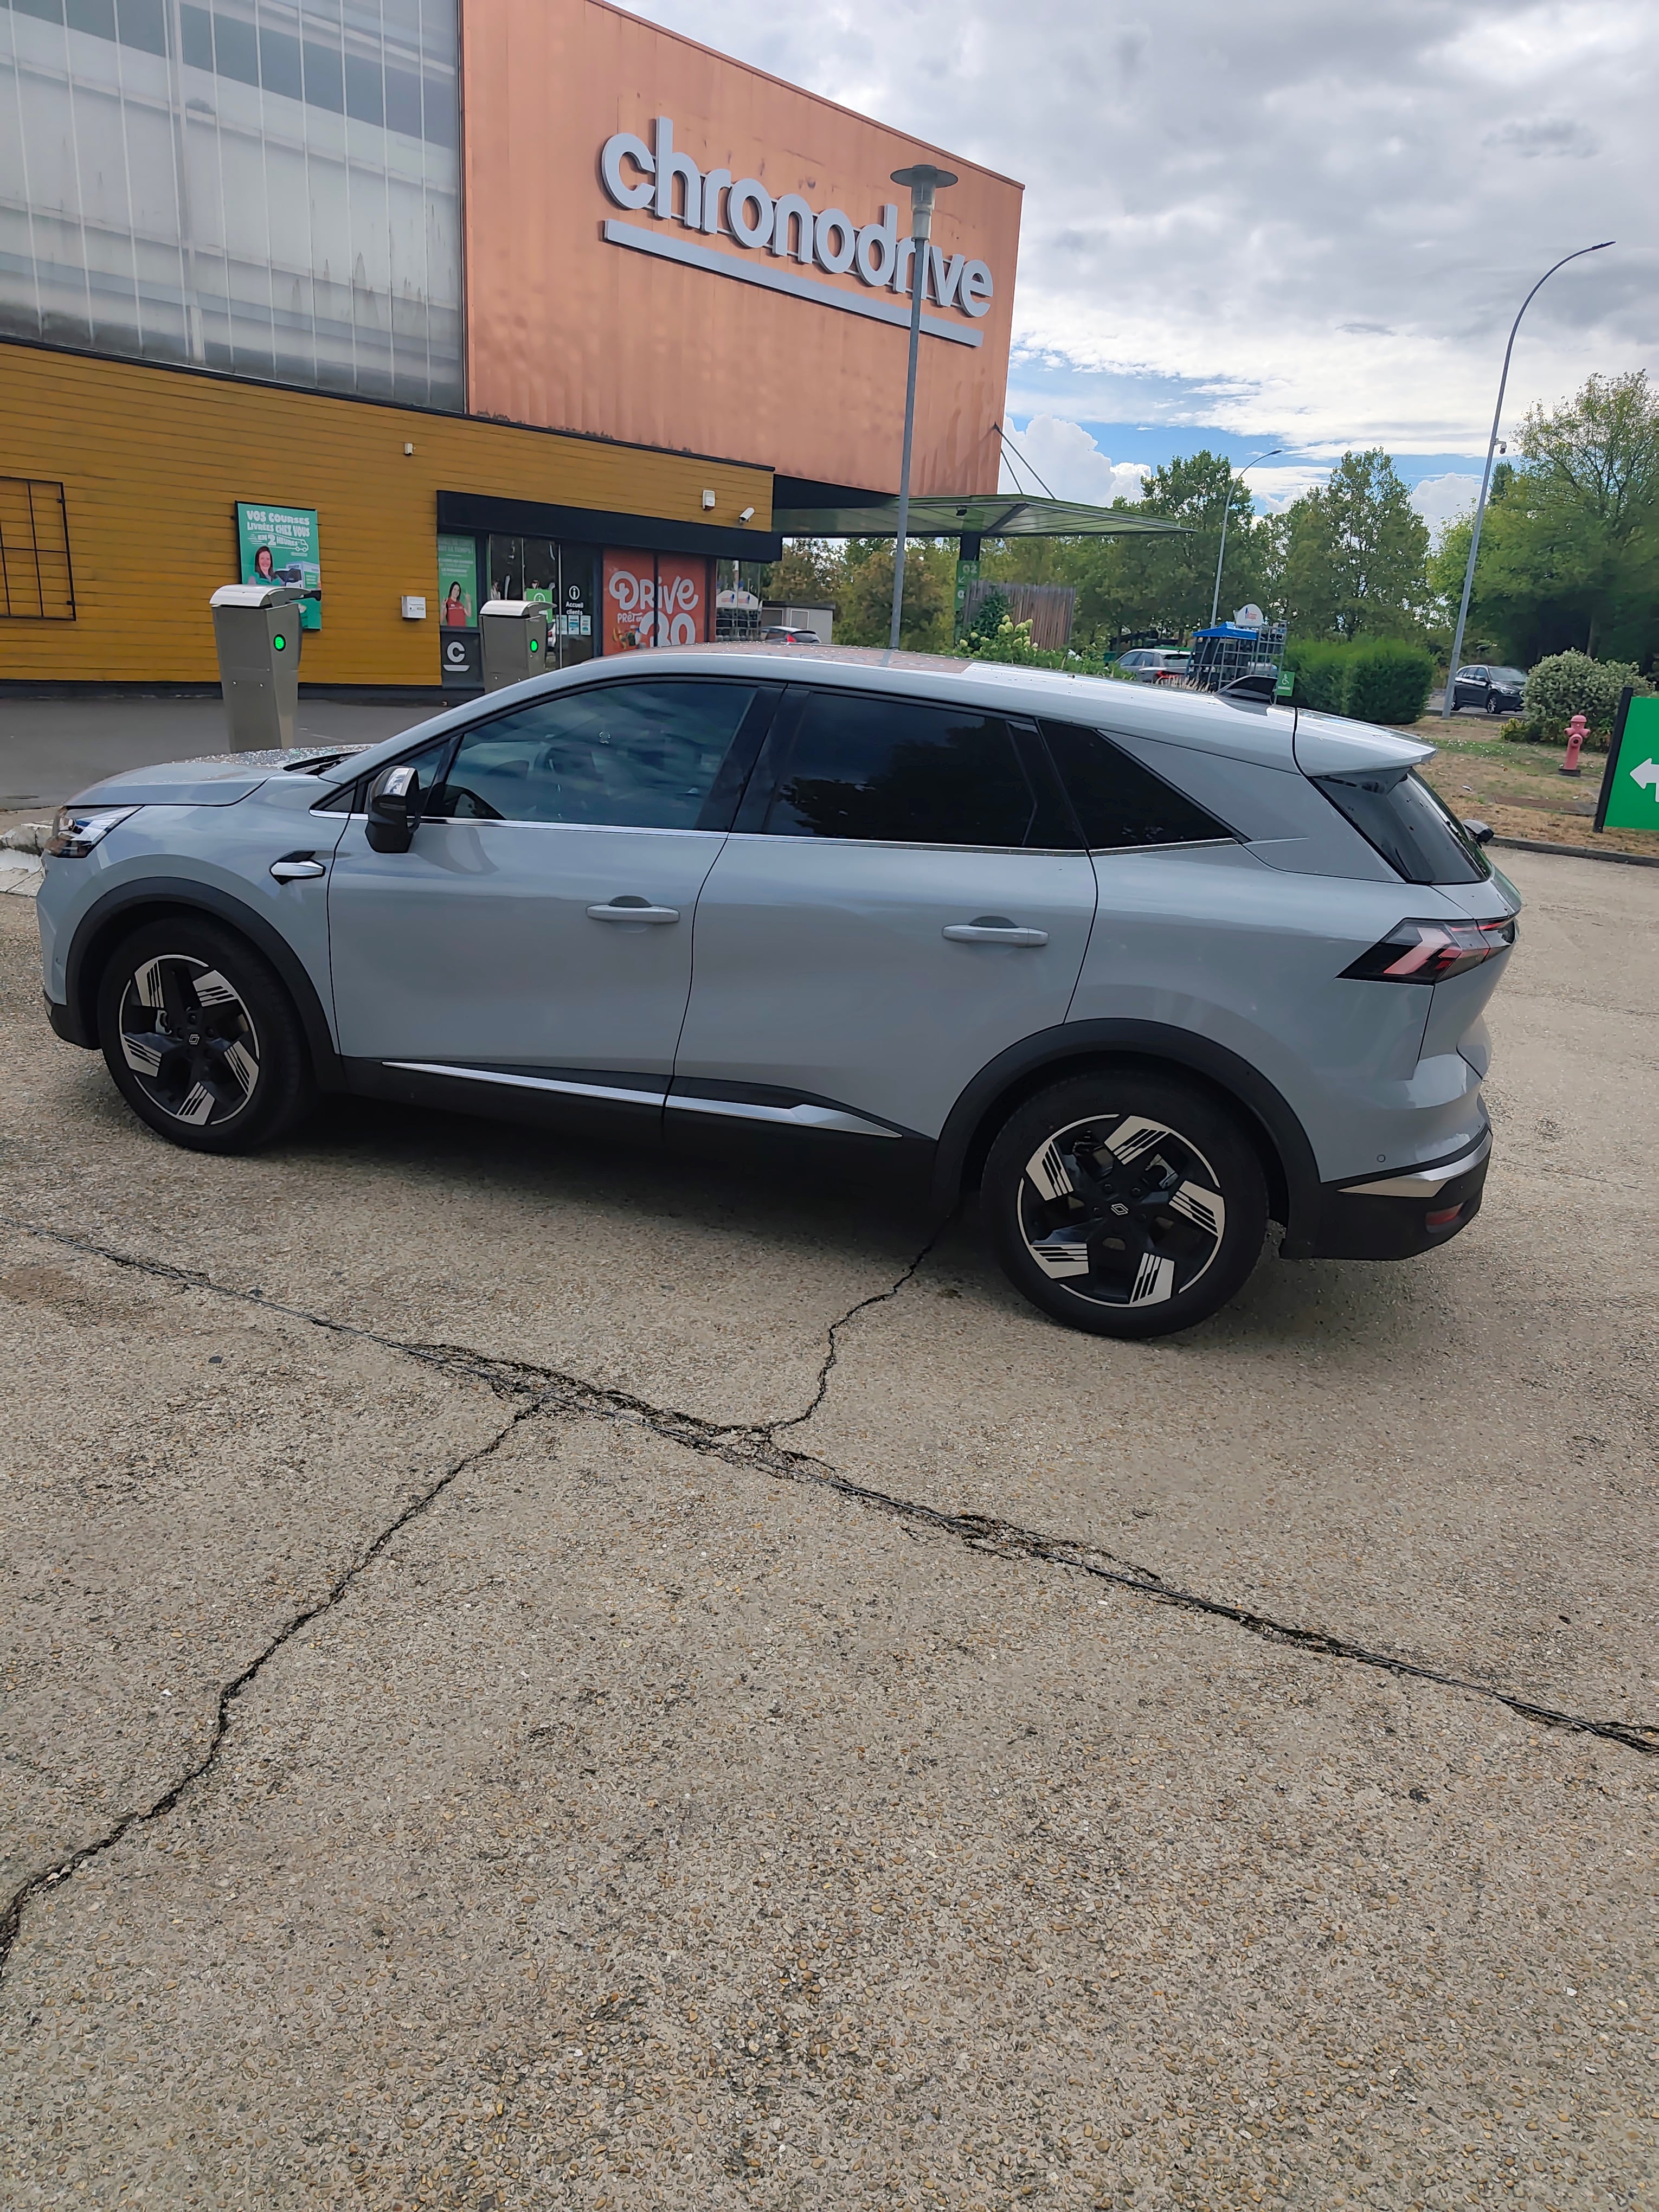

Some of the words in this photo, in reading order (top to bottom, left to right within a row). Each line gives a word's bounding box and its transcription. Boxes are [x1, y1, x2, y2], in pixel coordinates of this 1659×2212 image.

[247, 510, 266, 522] VOS
[268, 512, 310, 525] COURSES
[275, 524, 292, 536] CHEZ
[293, 525, 310, 537] VOUS
[268, 534, 276, 546] 2
